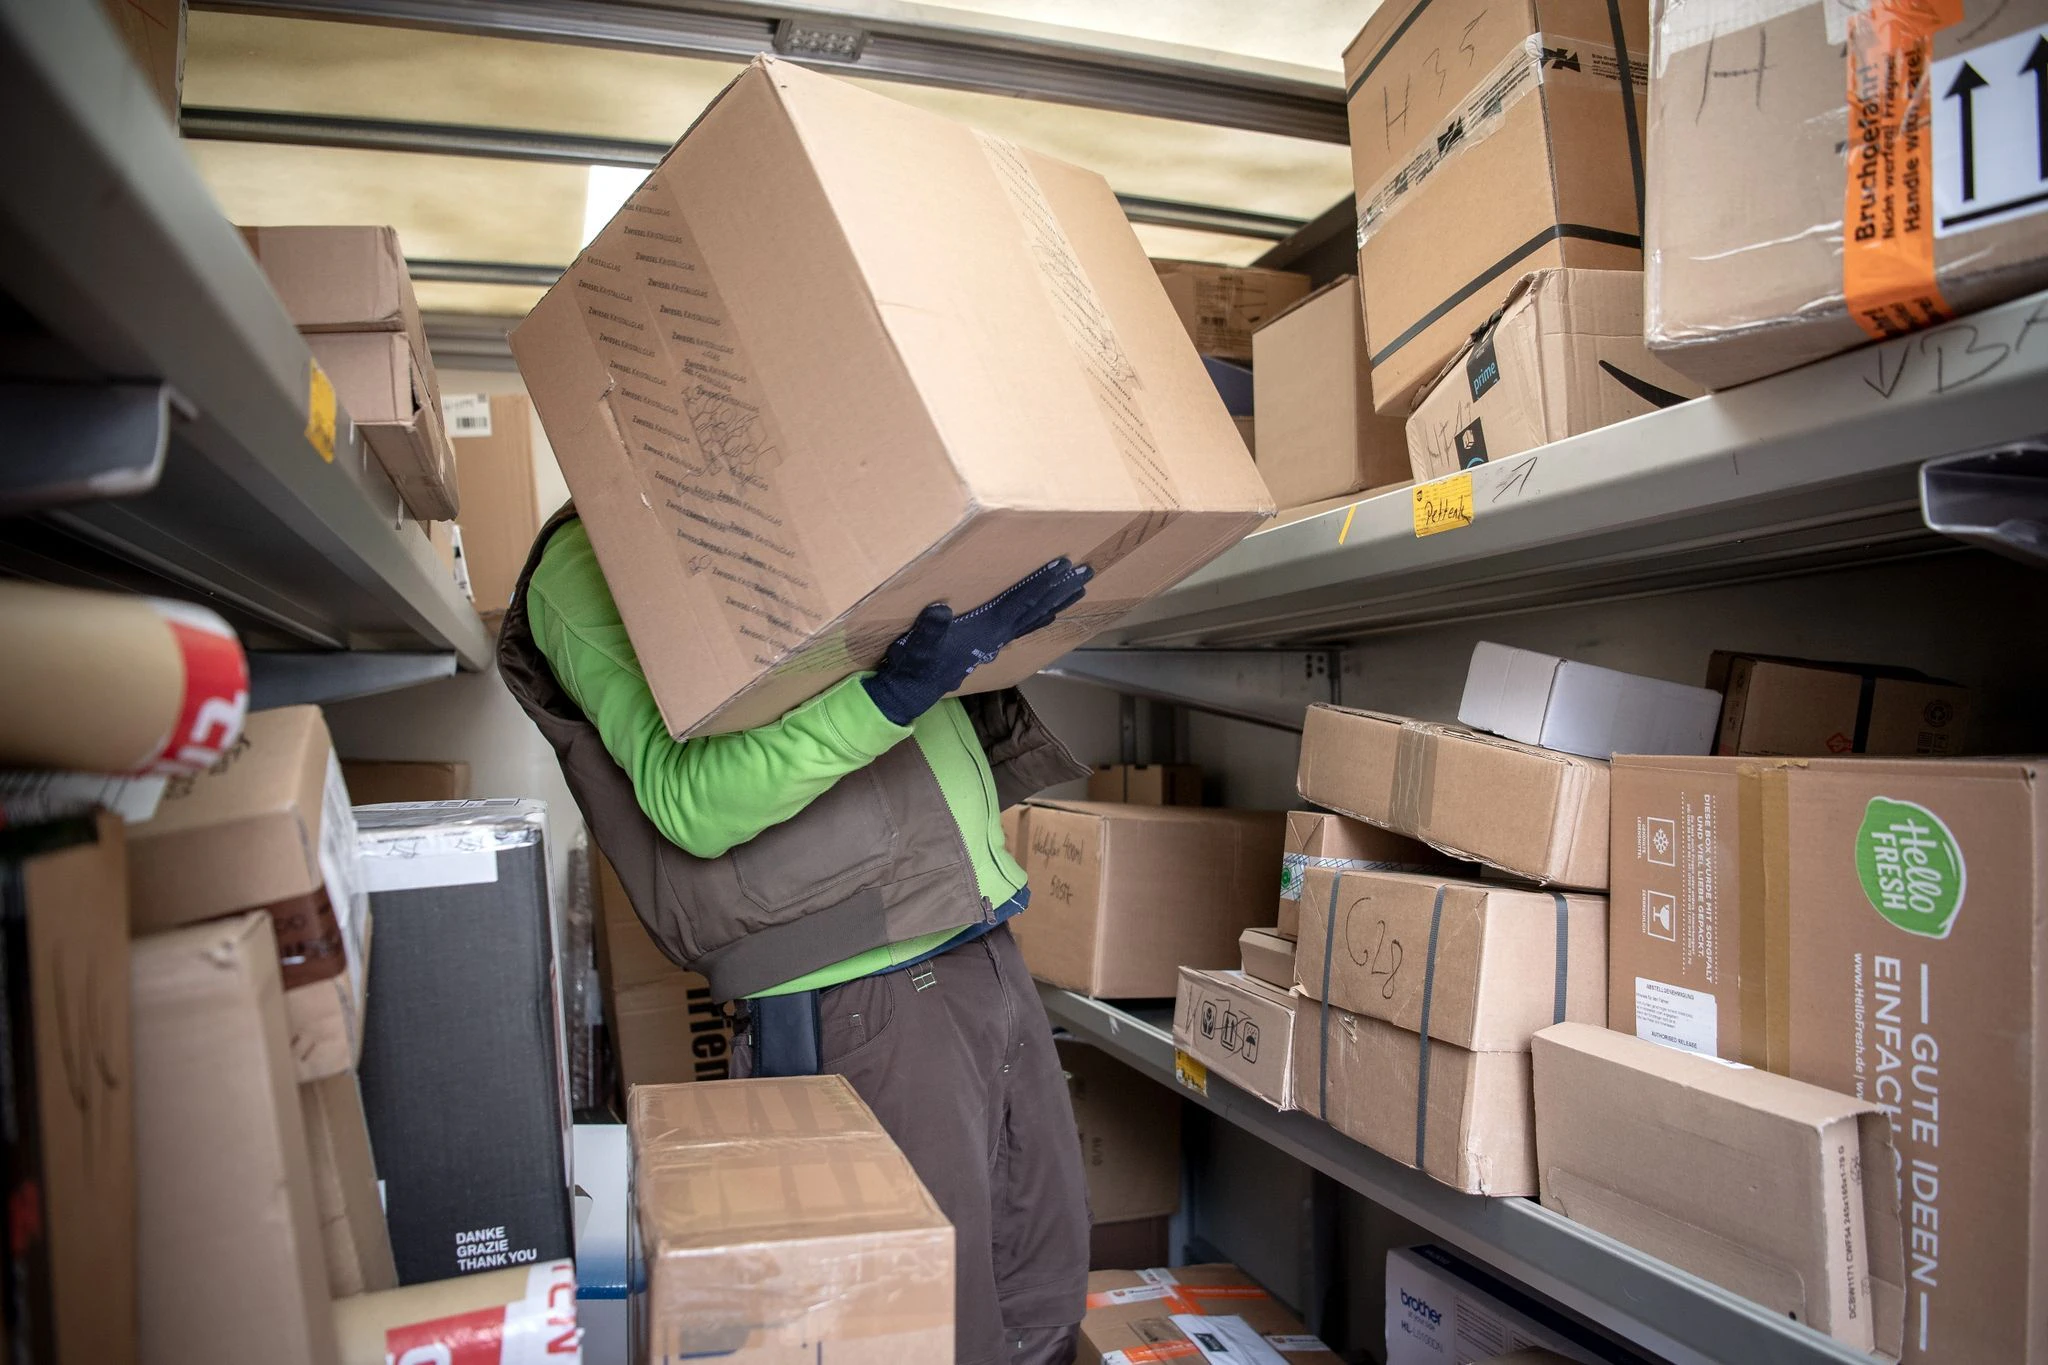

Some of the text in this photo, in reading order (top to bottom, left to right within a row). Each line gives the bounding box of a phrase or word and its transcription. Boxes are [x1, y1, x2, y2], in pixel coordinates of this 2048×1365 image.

[1905, 159, 1920, 234] Handle
[1473, 361, 1497, 395] prime
[1871, 832, 1908, 910] FRESH
[1889, 818, 1943, 913] Hello
[1705, 924, 1713, 984] SORGFALT
[1854, 953, 1866, 1073] www.HelloFresh.de
[1911, 1033, 1939, 1287] GUTE IDEEN
[456, 1226, 506, 1245] DANKE
[456, 1239, 509, 1258] GRAZIE
[457, 1248, 538, 1271] THANK YOU
[1400, 1288, 1442, 1326] brother
